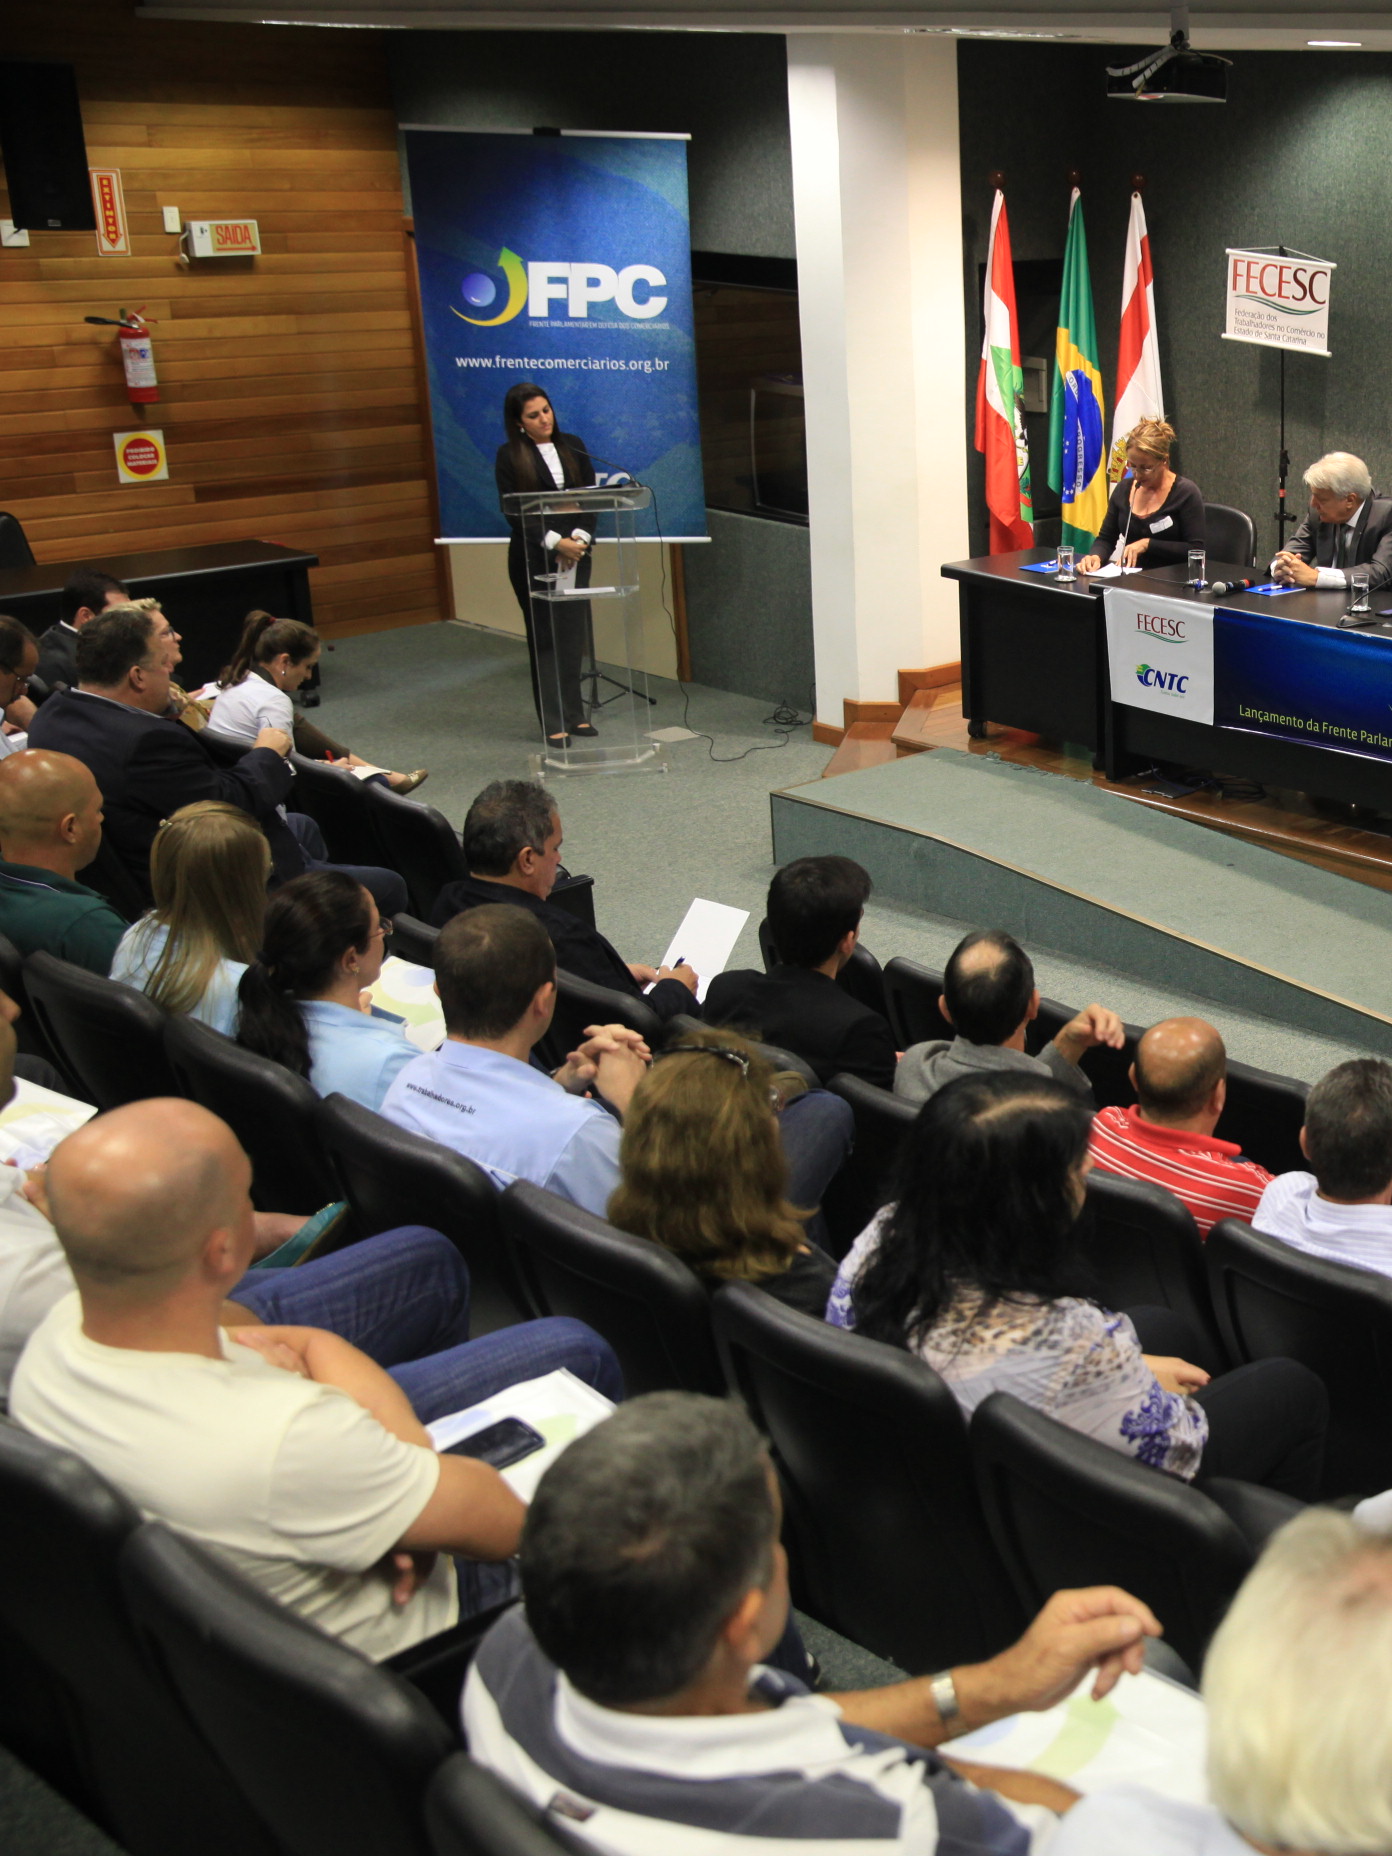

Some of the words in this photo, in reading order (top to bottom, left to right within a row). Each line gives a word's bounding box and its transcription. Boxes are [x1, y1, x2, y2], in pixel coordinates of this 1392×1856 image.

[528, 262, 668, 319] FPC
[1232, 258, 1328, 305] FECESC
[1234, 308, 1265, 320] Federação
[1266, 313, 1277, 322] dos
[1234, 326, 1253, 336] Estado
[1254, 330, 1263, 338] de
[1264, 331, 1280, 341] Santa
[1282, 334, 1307, 346] Catarina
[1235, 318, 1275, 331] Trabalhadores
[1286, 326, 1315, 338] Comércio
[456, 355, 669, 374] www.frentecomerciarios.org.br
[1137, 613, 1185, 638] FECESC
[1143, 668, 1189, 693] CNTC
[1239, 704, 1304, 730] Lançamento
[1306, 717, 1320, 732] da
[1322, 721, 1358, 741] Frente
